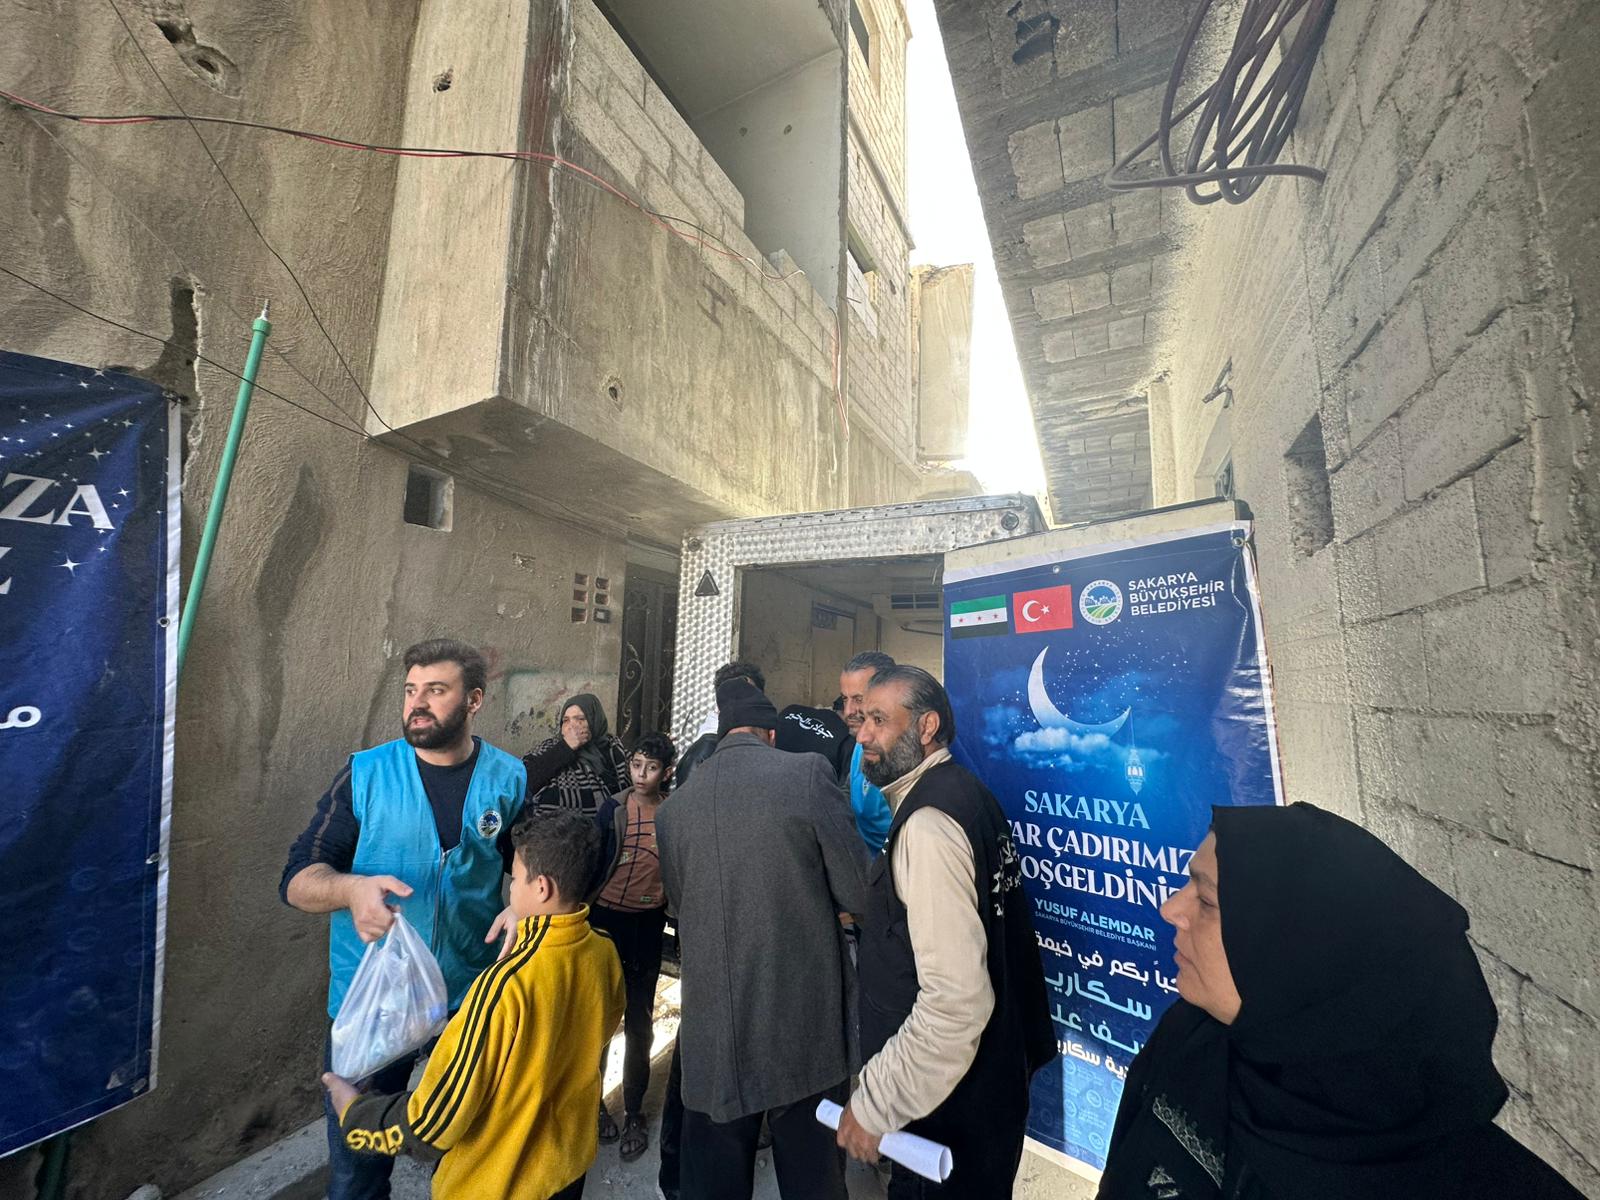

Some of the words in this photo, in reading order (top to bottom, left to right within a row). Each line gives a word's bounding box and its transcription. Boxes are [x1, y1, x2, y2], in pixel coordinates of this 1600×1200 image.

[1128, 571, 1198, 591] SAKARYA
[1129, 580, 1225, 604] BÜYÜKŞEHİR
[1130, 593, 1217, 616] BELEDİYESİ
[1024, 790, 1150, 829] SAKARYA
[1017, 853, 1181, 910] OŞGELDİNİ
[1034, 898, 1078, 919] YUSUF
[1080, 911, 1156, 942] ALEMDAR
[1034, 930, 1073, 958] خيمة
[1077, 950, 1104, 970] في
[1108, 959, 1149, 987] بكم
